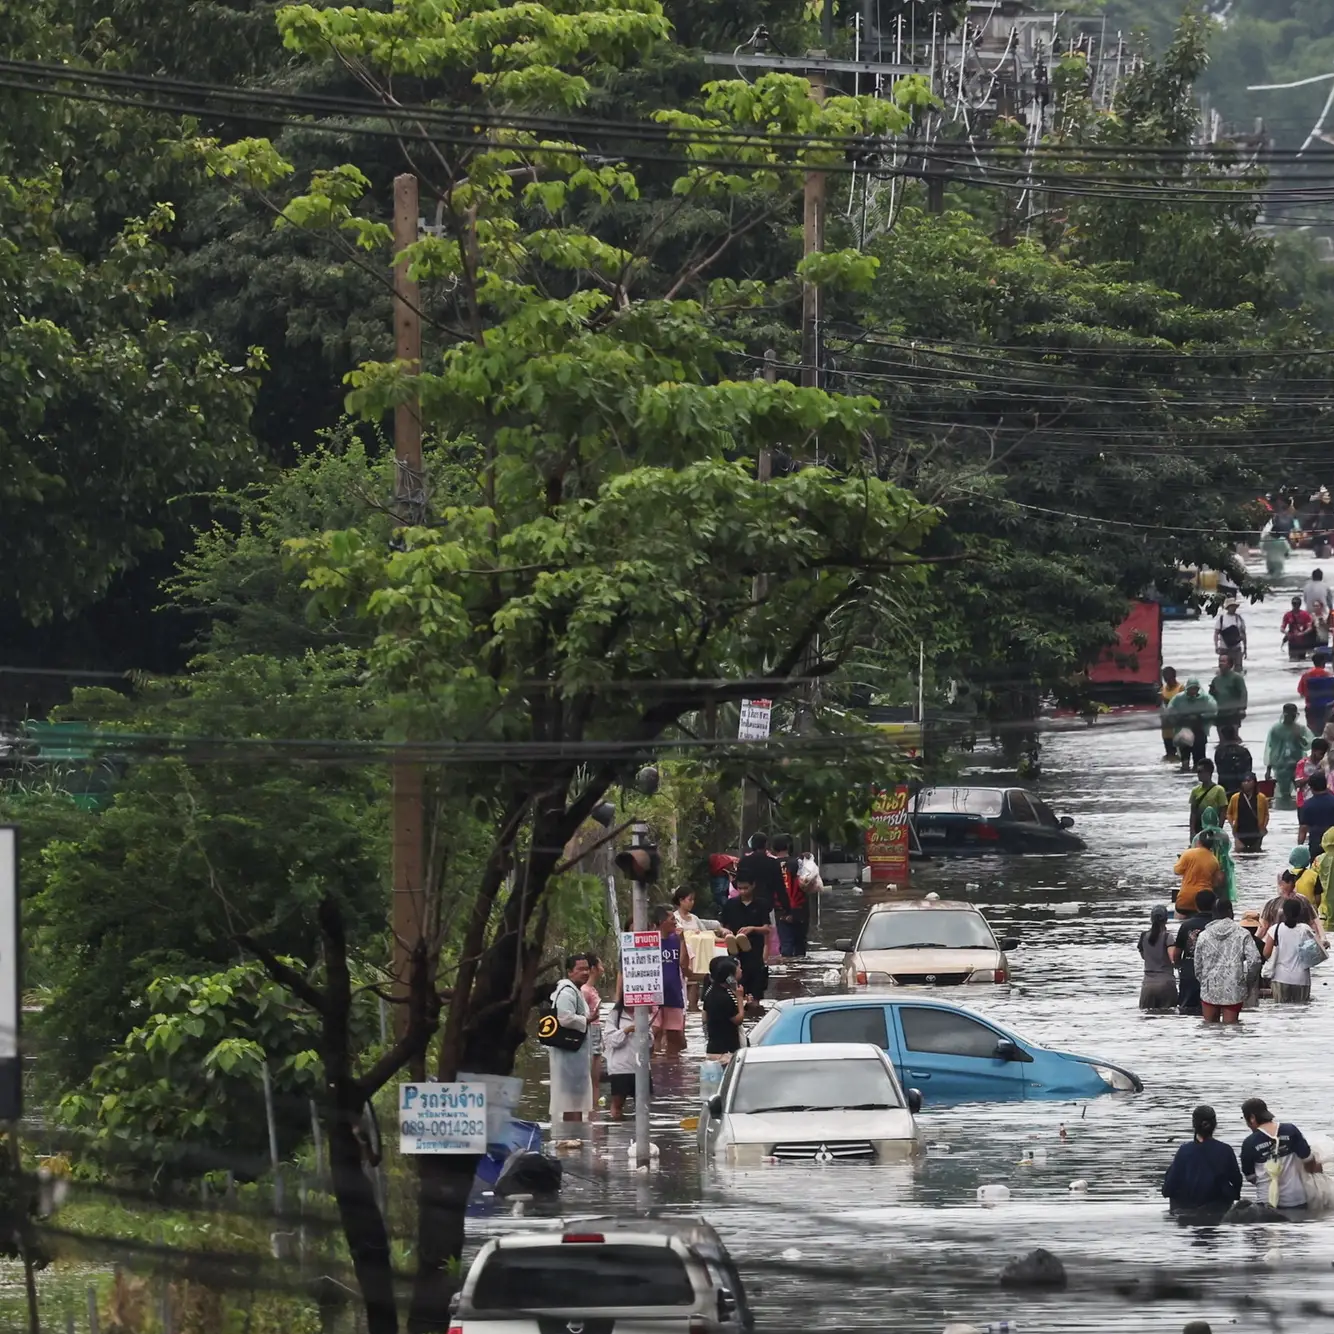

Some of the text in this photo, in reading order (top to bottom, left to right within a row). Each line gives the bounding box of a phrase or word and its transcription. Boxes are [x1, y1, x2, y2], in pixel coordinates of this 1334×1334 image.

[401, 1085, 418, 1109] P
[420, 1085, 484, 1109] รถรับจ้าง
[401, 1120, 484, 1137] 089-0014282
